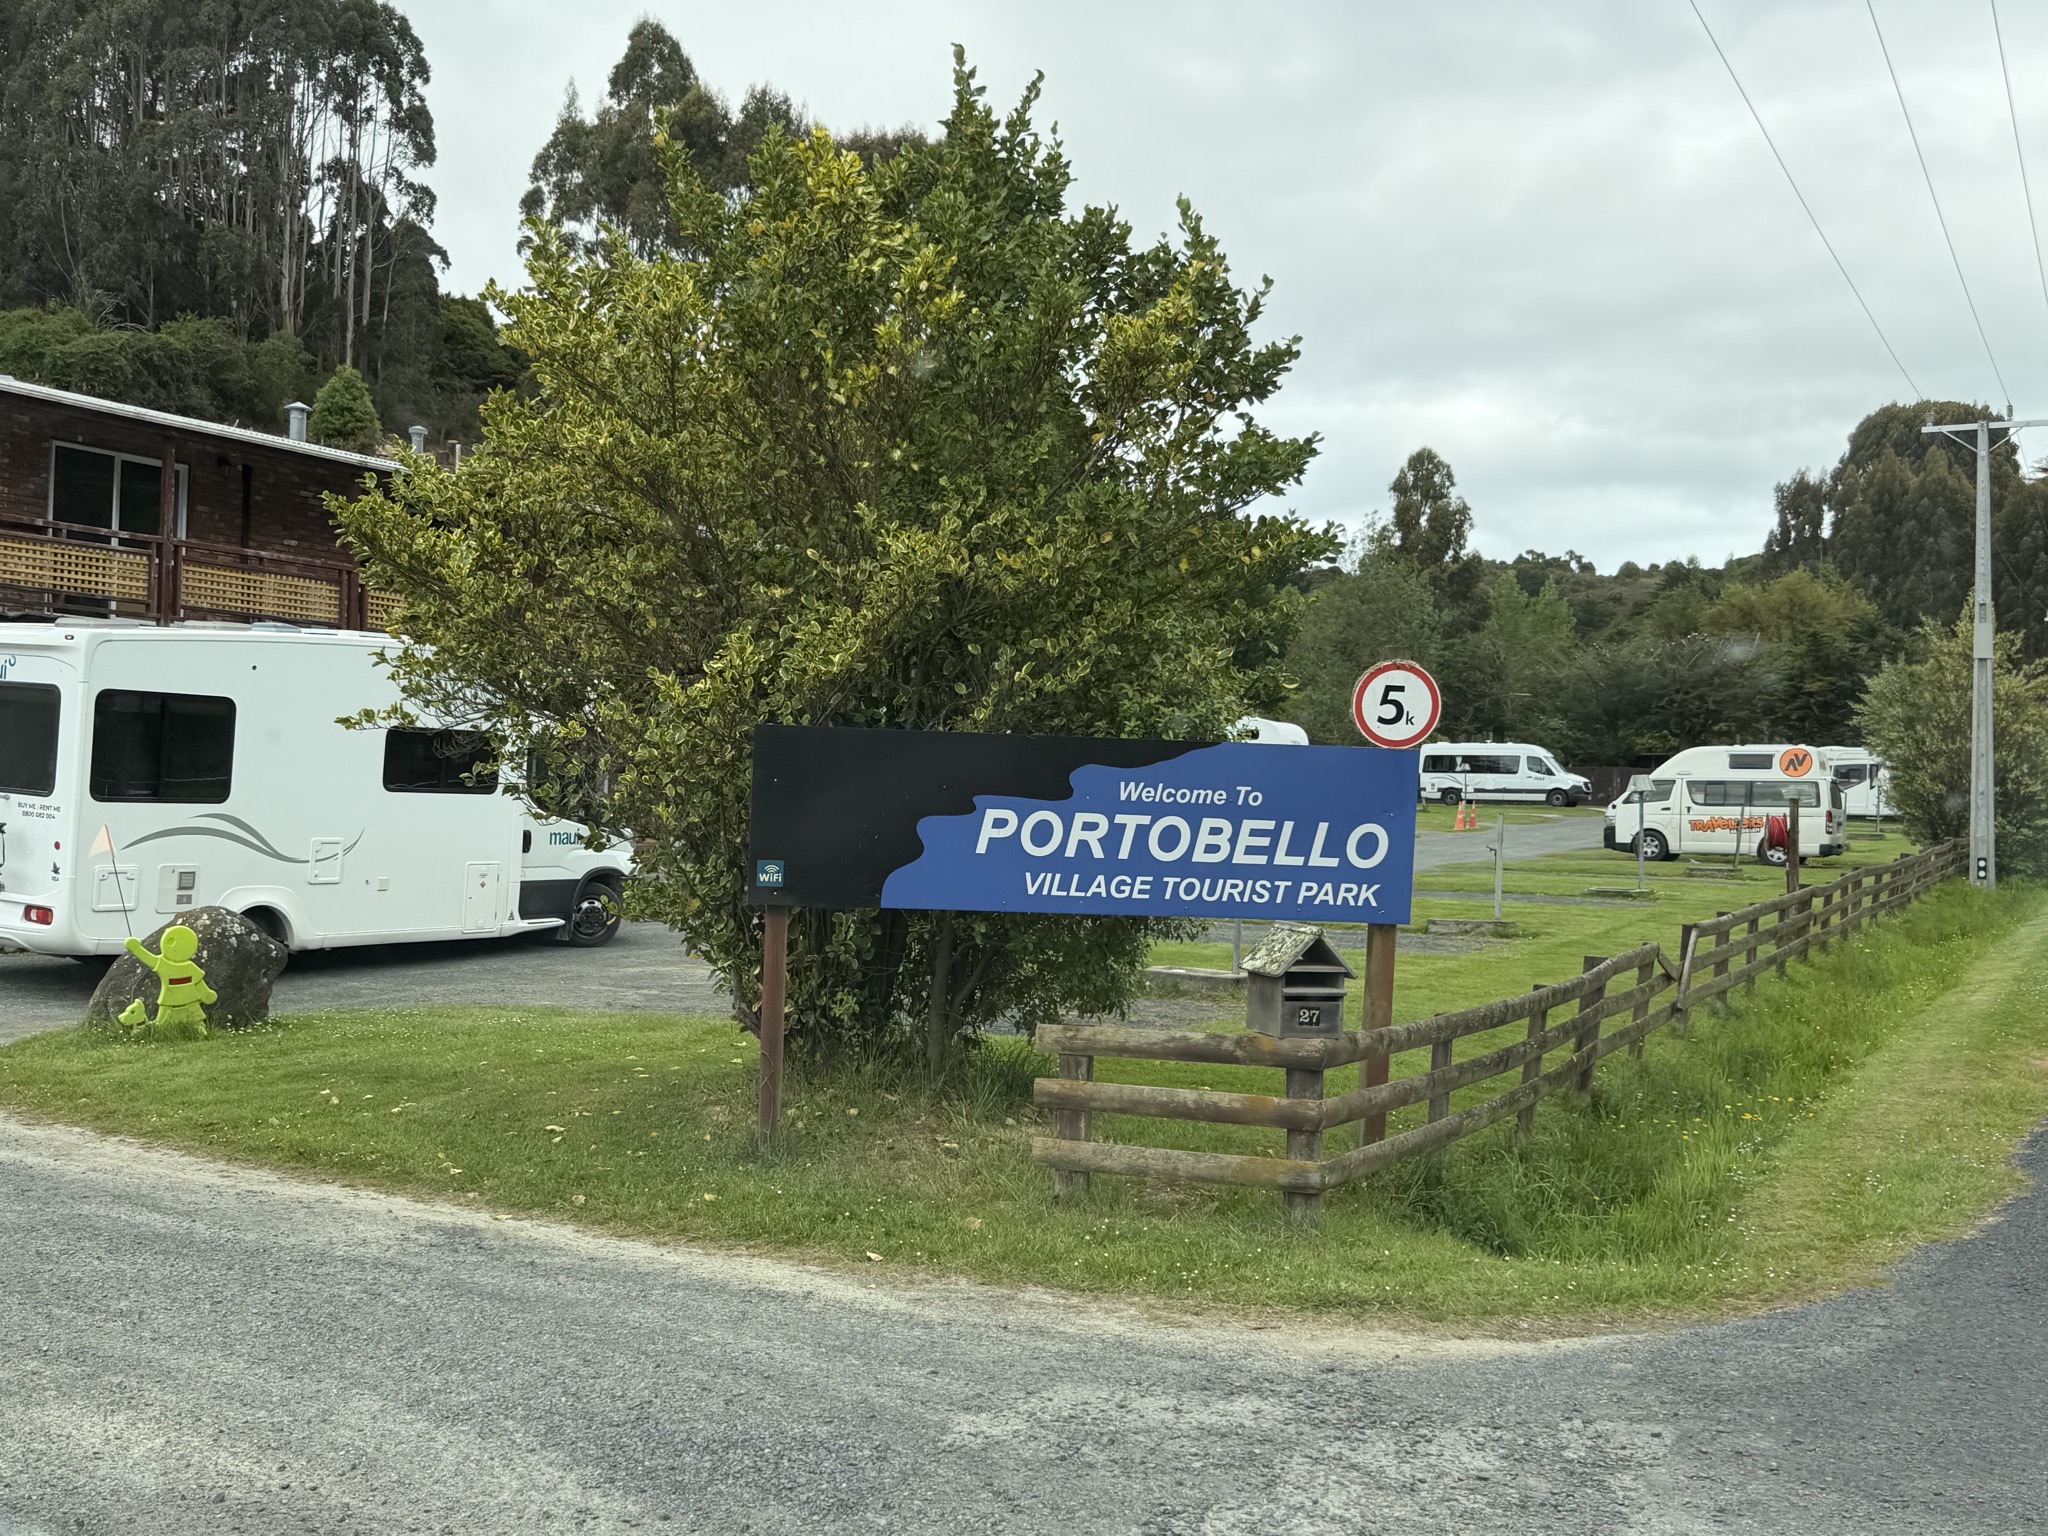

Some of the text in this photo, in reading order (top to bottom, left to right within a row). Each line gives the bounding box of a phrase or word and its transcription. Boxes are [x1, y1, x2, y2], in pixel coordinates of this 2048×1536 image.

[1118, 781, 1264, 807] Welcome To
[974, 808, 1390, 869] PORTOBELLO
[758, 872, 782, 883] WiFi
[1024, 871, 1381, 907] VILLAGE TOURIST PARK
[1299, 1008, 1320, 1023] 27
